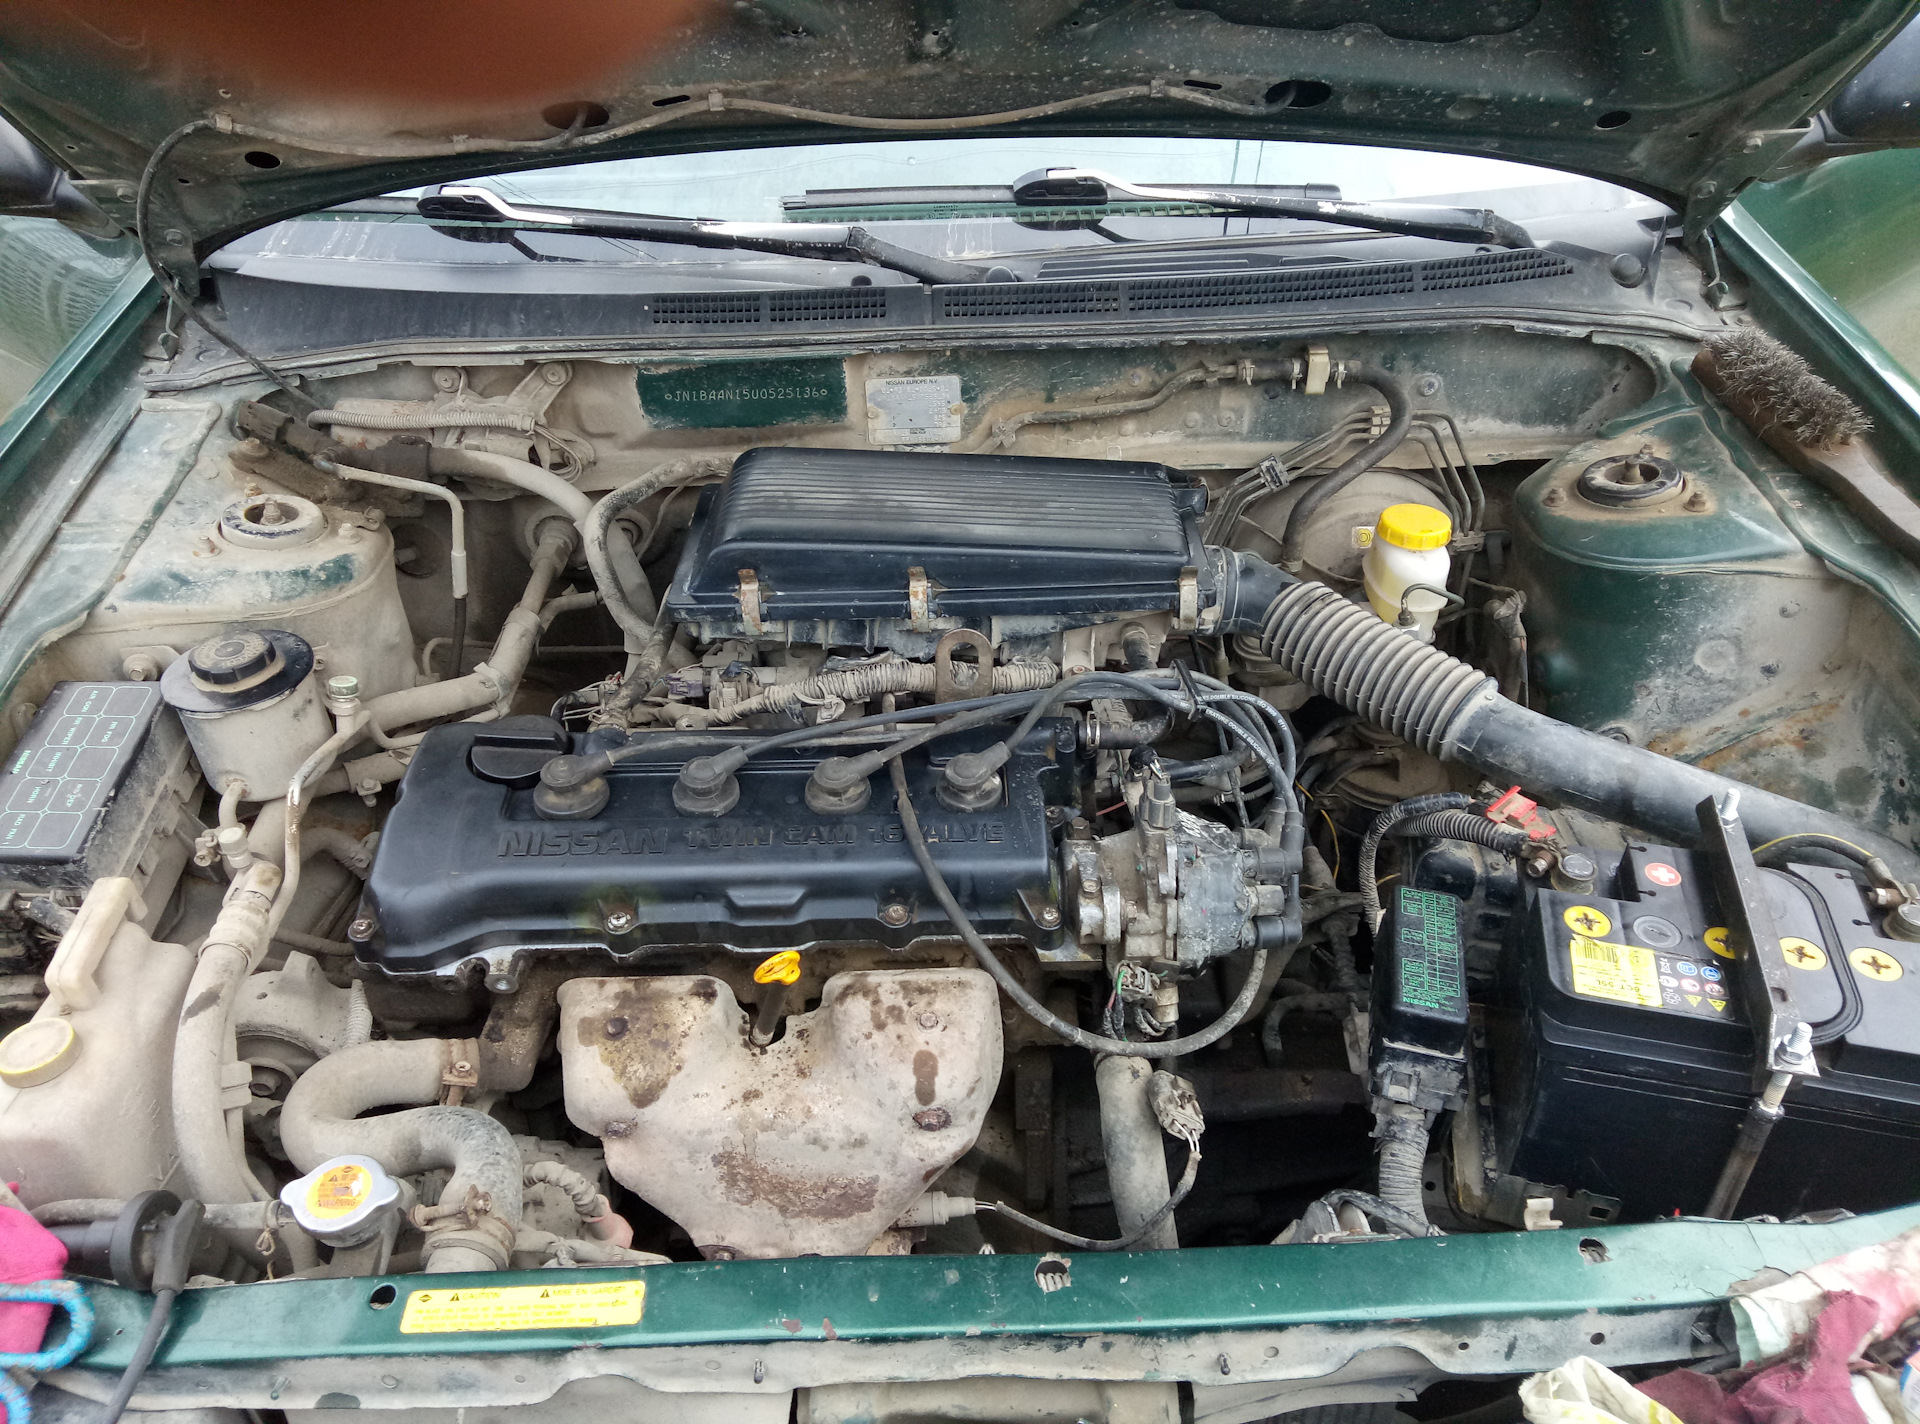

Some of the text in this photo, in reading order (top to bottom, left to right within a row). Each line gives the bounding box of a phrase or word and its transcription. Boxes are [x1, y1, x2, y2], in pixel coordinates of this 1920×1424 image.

[1205, 708, 1230, 725] ERATURE
[1228, 721, 1248, 739] DOUBLE
[1246, 736, 1268, 757] SILICONE
[11, 750, 32, 774] NISSAN
[26, 786, 42, 804] HORN
[498, 828, 669, 858] NISSAN
[683, 825, 774, 850] TWIN
[782, 824, 857, 846] CAM
[867, 823, 904, 844] 16
[1403, 997, 1439, 1008] NISSAN
[462, 1292, 501, 1300] CAUTION
[576, 1288, 588, 1296] EN
